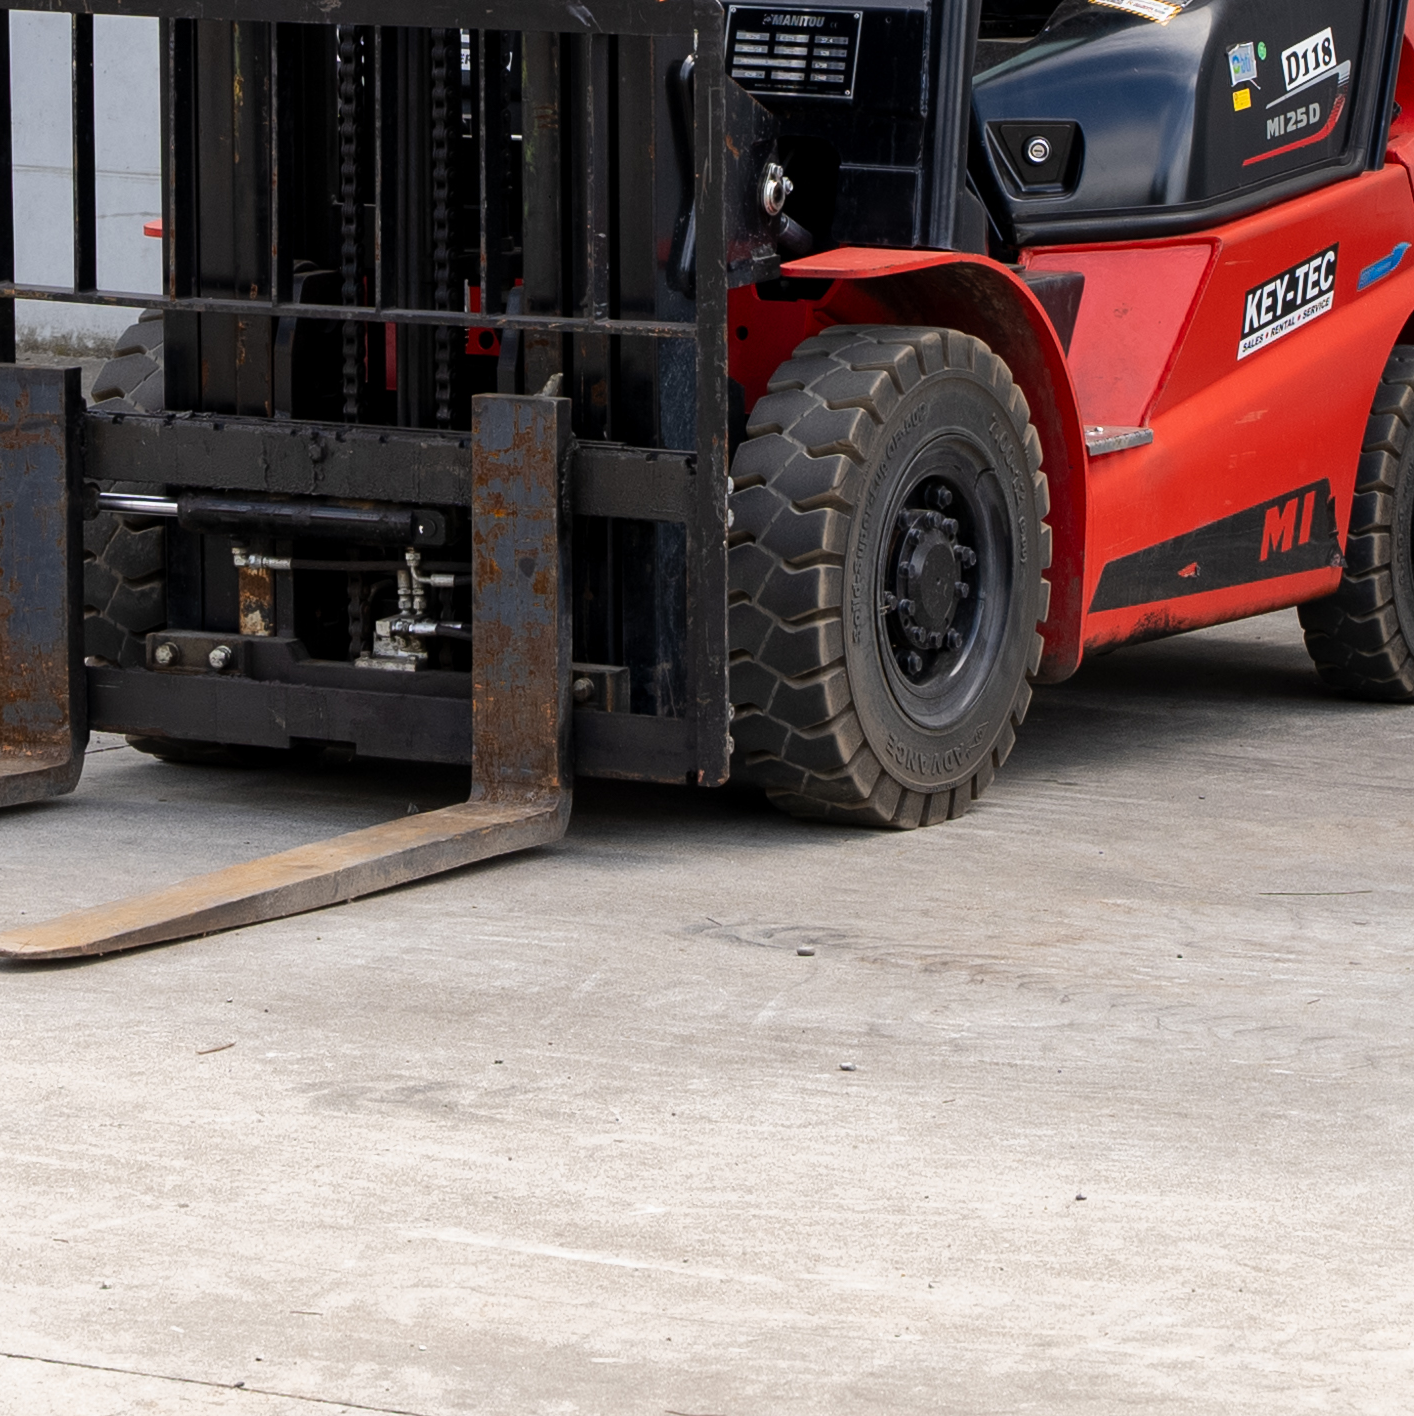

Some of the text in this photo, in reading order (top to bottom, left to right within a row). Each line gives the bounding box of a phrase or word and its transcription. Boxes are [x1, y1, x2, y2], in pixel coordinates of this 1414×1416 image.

[772, 14, 825, 27] MANITOU
[1286, 37, 1332, 86] D118
[1244, 251, 1335, 333] KEY-TEC
[1242, 297, 1330, 352] SALES RENTAL SERVICE
[1259, 491, 1316, 562] MI
[885, 732, 964, 777] ADVANCE
